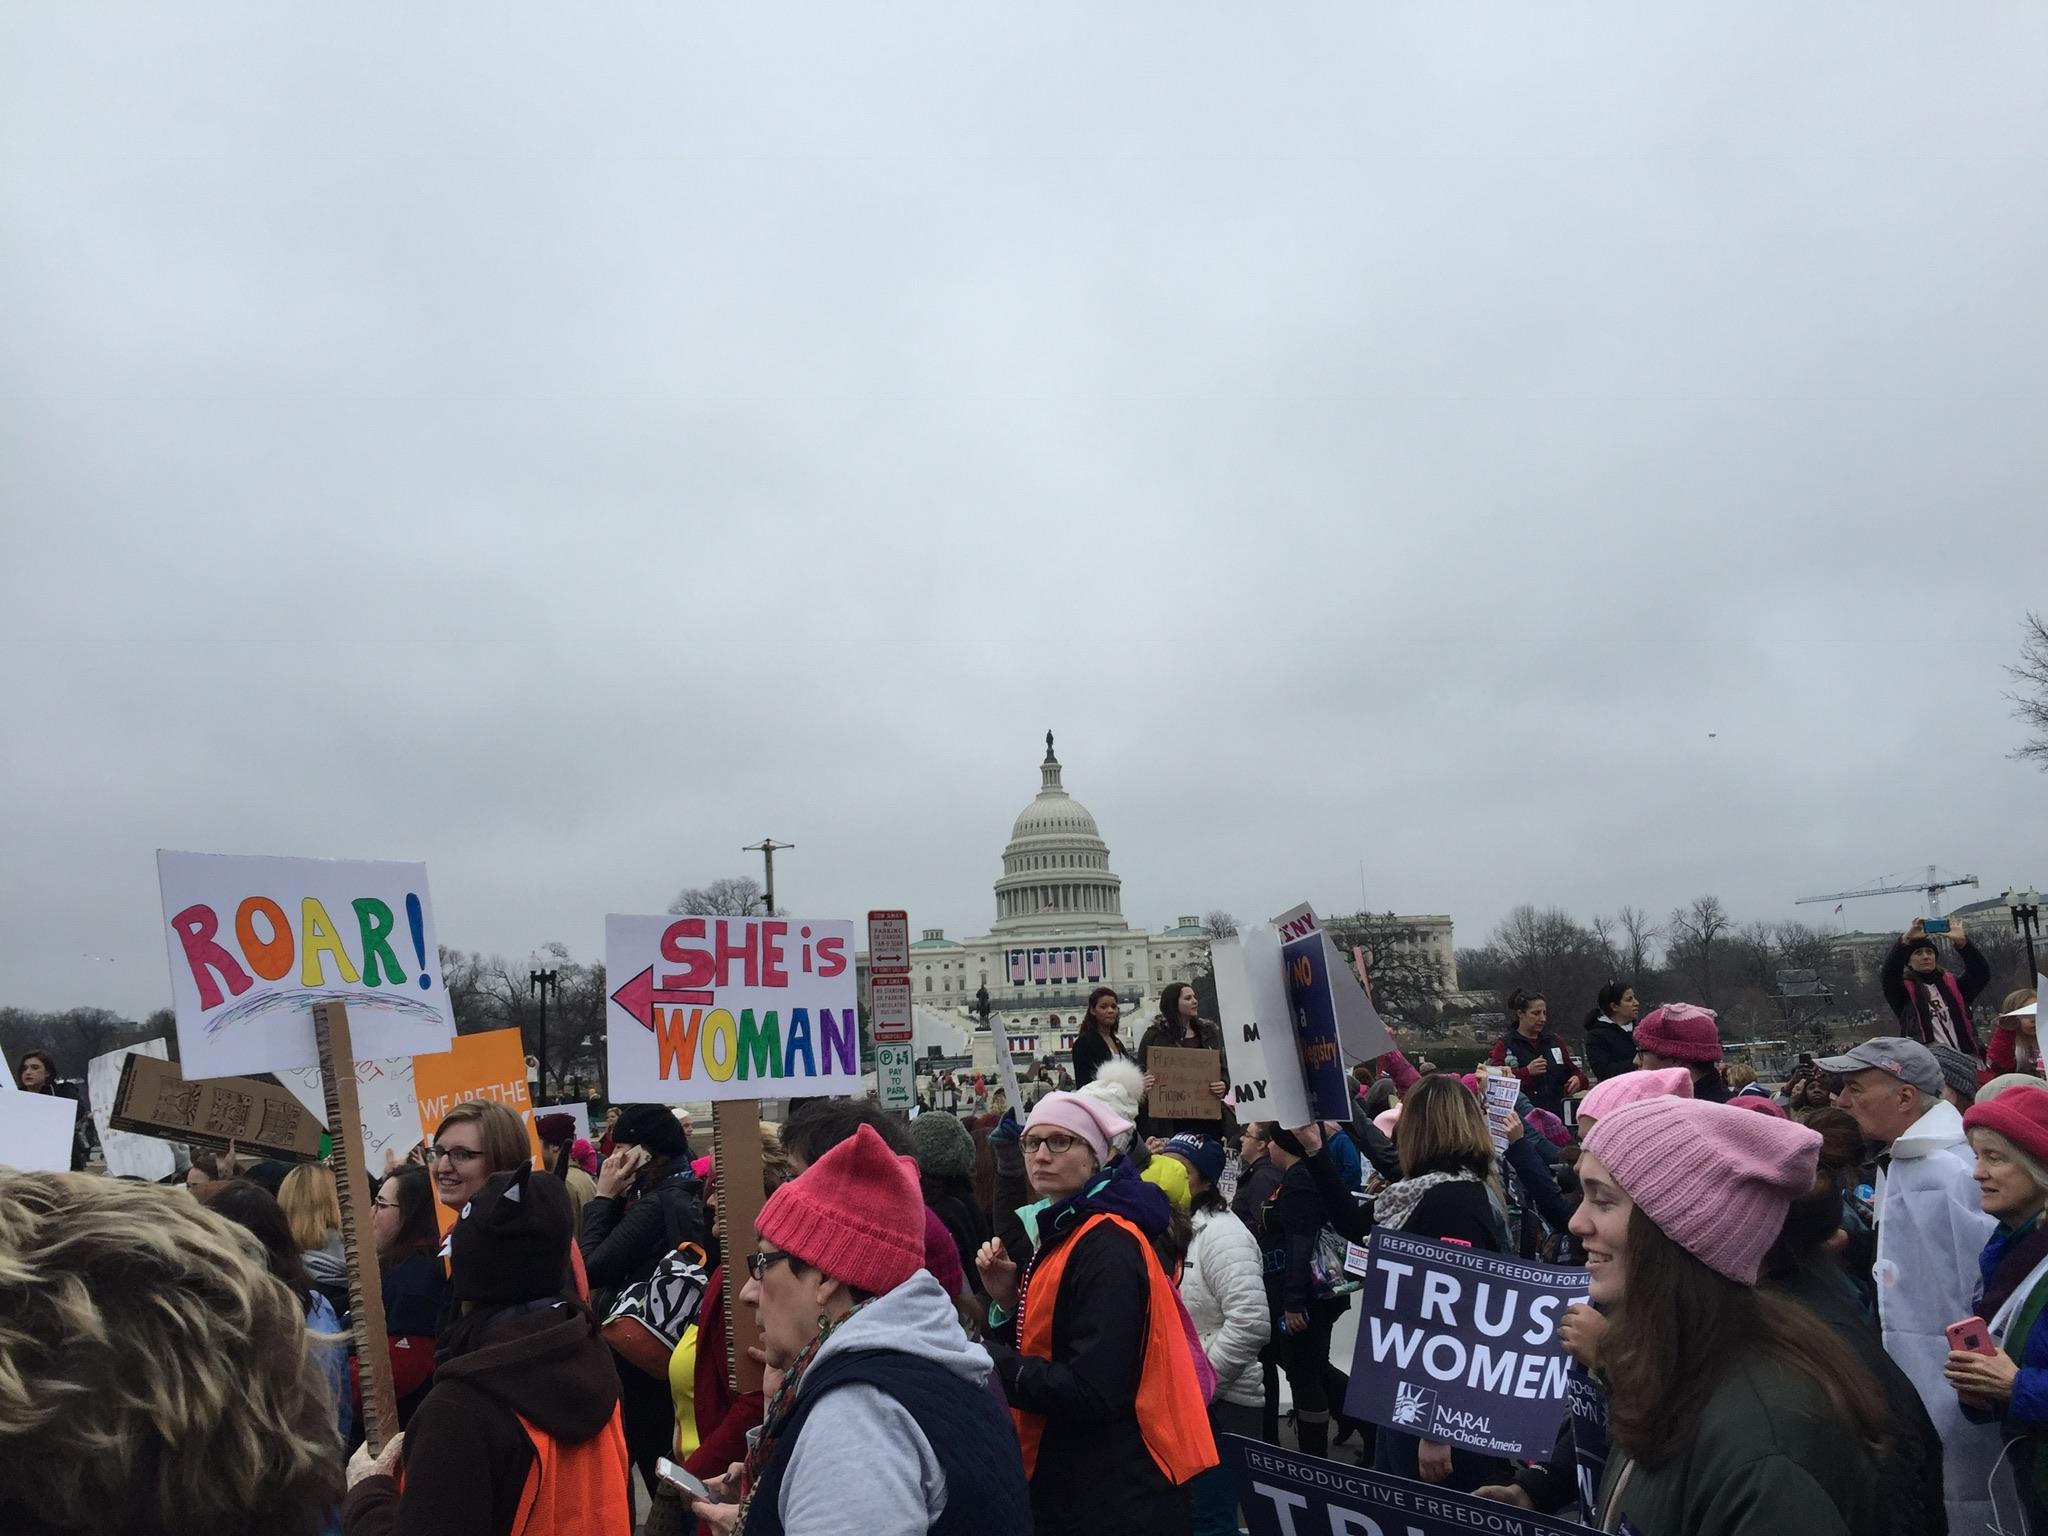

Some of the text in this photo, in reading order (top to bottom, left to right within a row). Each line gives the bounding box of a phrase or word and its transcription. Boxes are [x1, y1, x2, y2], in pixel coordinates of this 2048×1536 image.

[171, 892, 431, 1011] ROAR!
[660, 918, 847, 990] SHE is
[653, 1008, 857, 1083] WOMAN
[886, 1086, 906, 1095] PARK
[889, 1067, 903, 1076] PAY
[891, 1077, 902, 1085] TO
[1235, 1079, 1267, 1104] MY
[420, 1094, 450, 1121] WE
[487, 1080, 527, 1104] THE
[1382, 1237, 1484, 1270] REPRODUCTIVE
[1488, 1261, 1553, 1284] FREEDOM
[1556, 1275, 1578, 1286] FOR
[1369, 1316, 1573, 1400] WOMEN
[1432, 1422, 1522, 1453] Pro-Choice America
[1435, 1404, 1492, 1434] NARAL
[1252, 1452, 1523, 1536] REPRODUCTIVE FREEDOM
